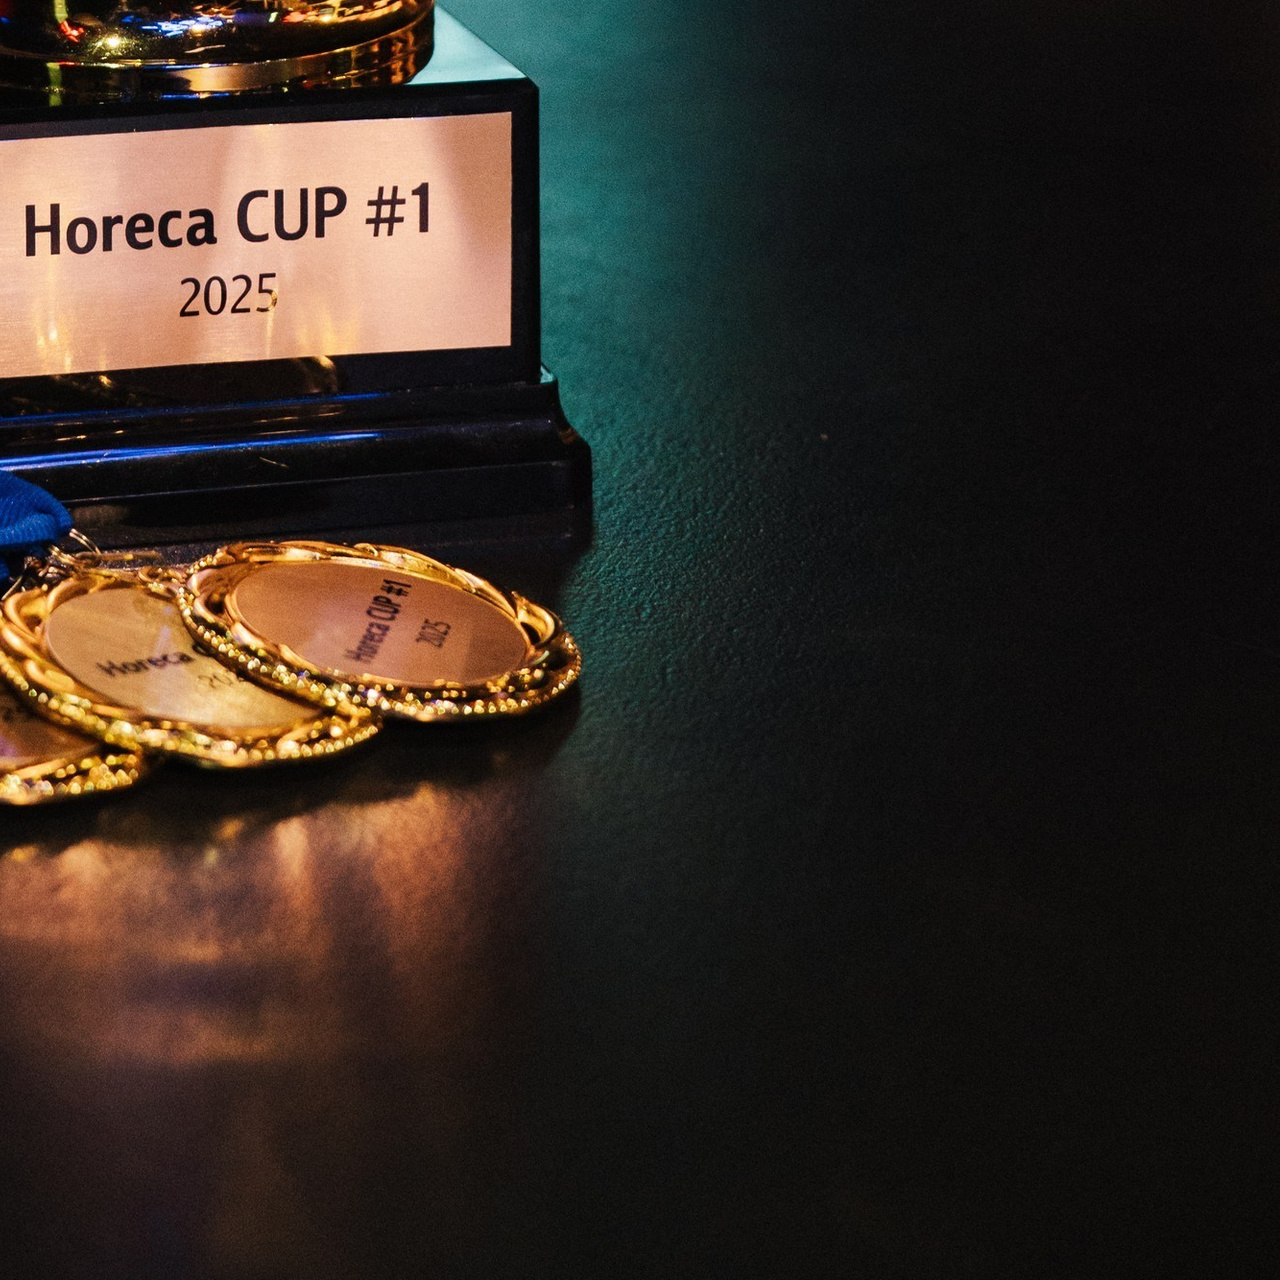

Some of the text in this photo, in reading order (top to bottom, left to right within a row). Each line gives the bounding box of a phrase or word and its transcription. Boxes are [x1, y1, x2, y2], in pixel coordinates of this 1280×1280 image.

[24, 182, 430, 257] Horeca CUP #1
[178, 272, 279, 317] 2025
[344, 578, 412, 664] Horeca CUP #1
[415, 618, 452, 649] 2025
[95, 651, 195, 678] Horeca
